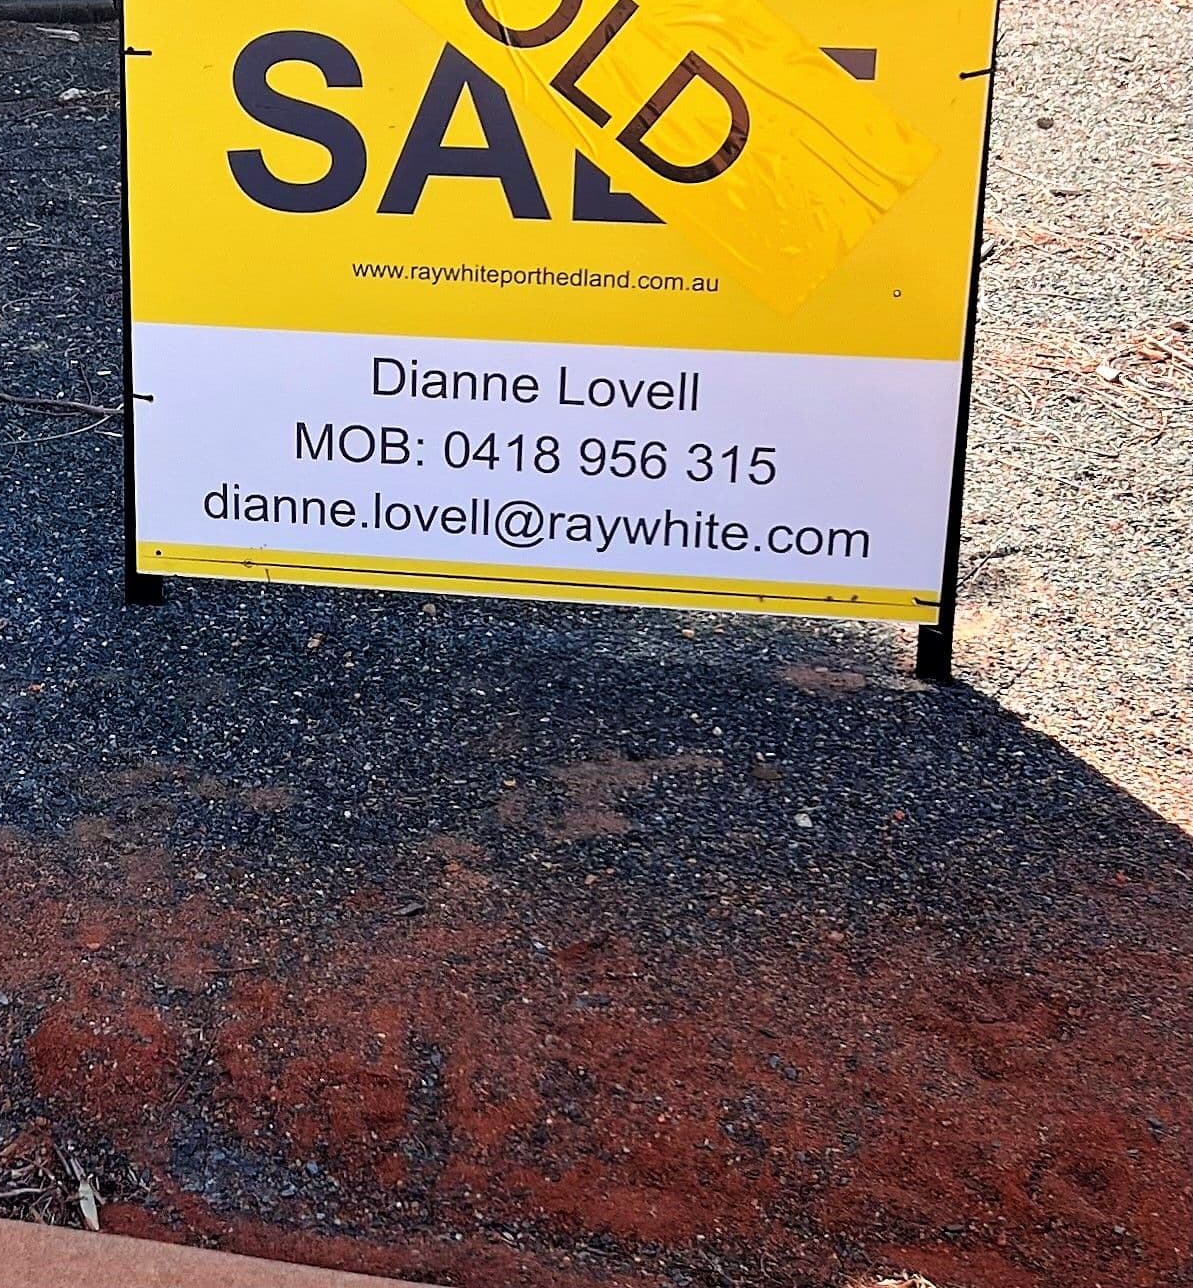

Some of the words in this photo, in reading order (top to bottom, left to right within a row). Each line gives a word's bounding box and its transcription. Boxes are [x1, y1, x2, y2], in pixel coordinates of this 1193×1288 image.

[226, 30, 877, 225] SA
[351, 262, 720, 293] www.raywhiteporthedland.com.au
[372, 356, 539, 404] Dianne
[559, 366, 700, 412] Lovell
[295, 421, 424, 467] MOB:
[443, 430, 560, 474] 0418
[579, 437, 668, 480] 956
[686, 443, 777, 486] 315
[203, 482, 871, 559] dianne.lovell@raywhite.com
